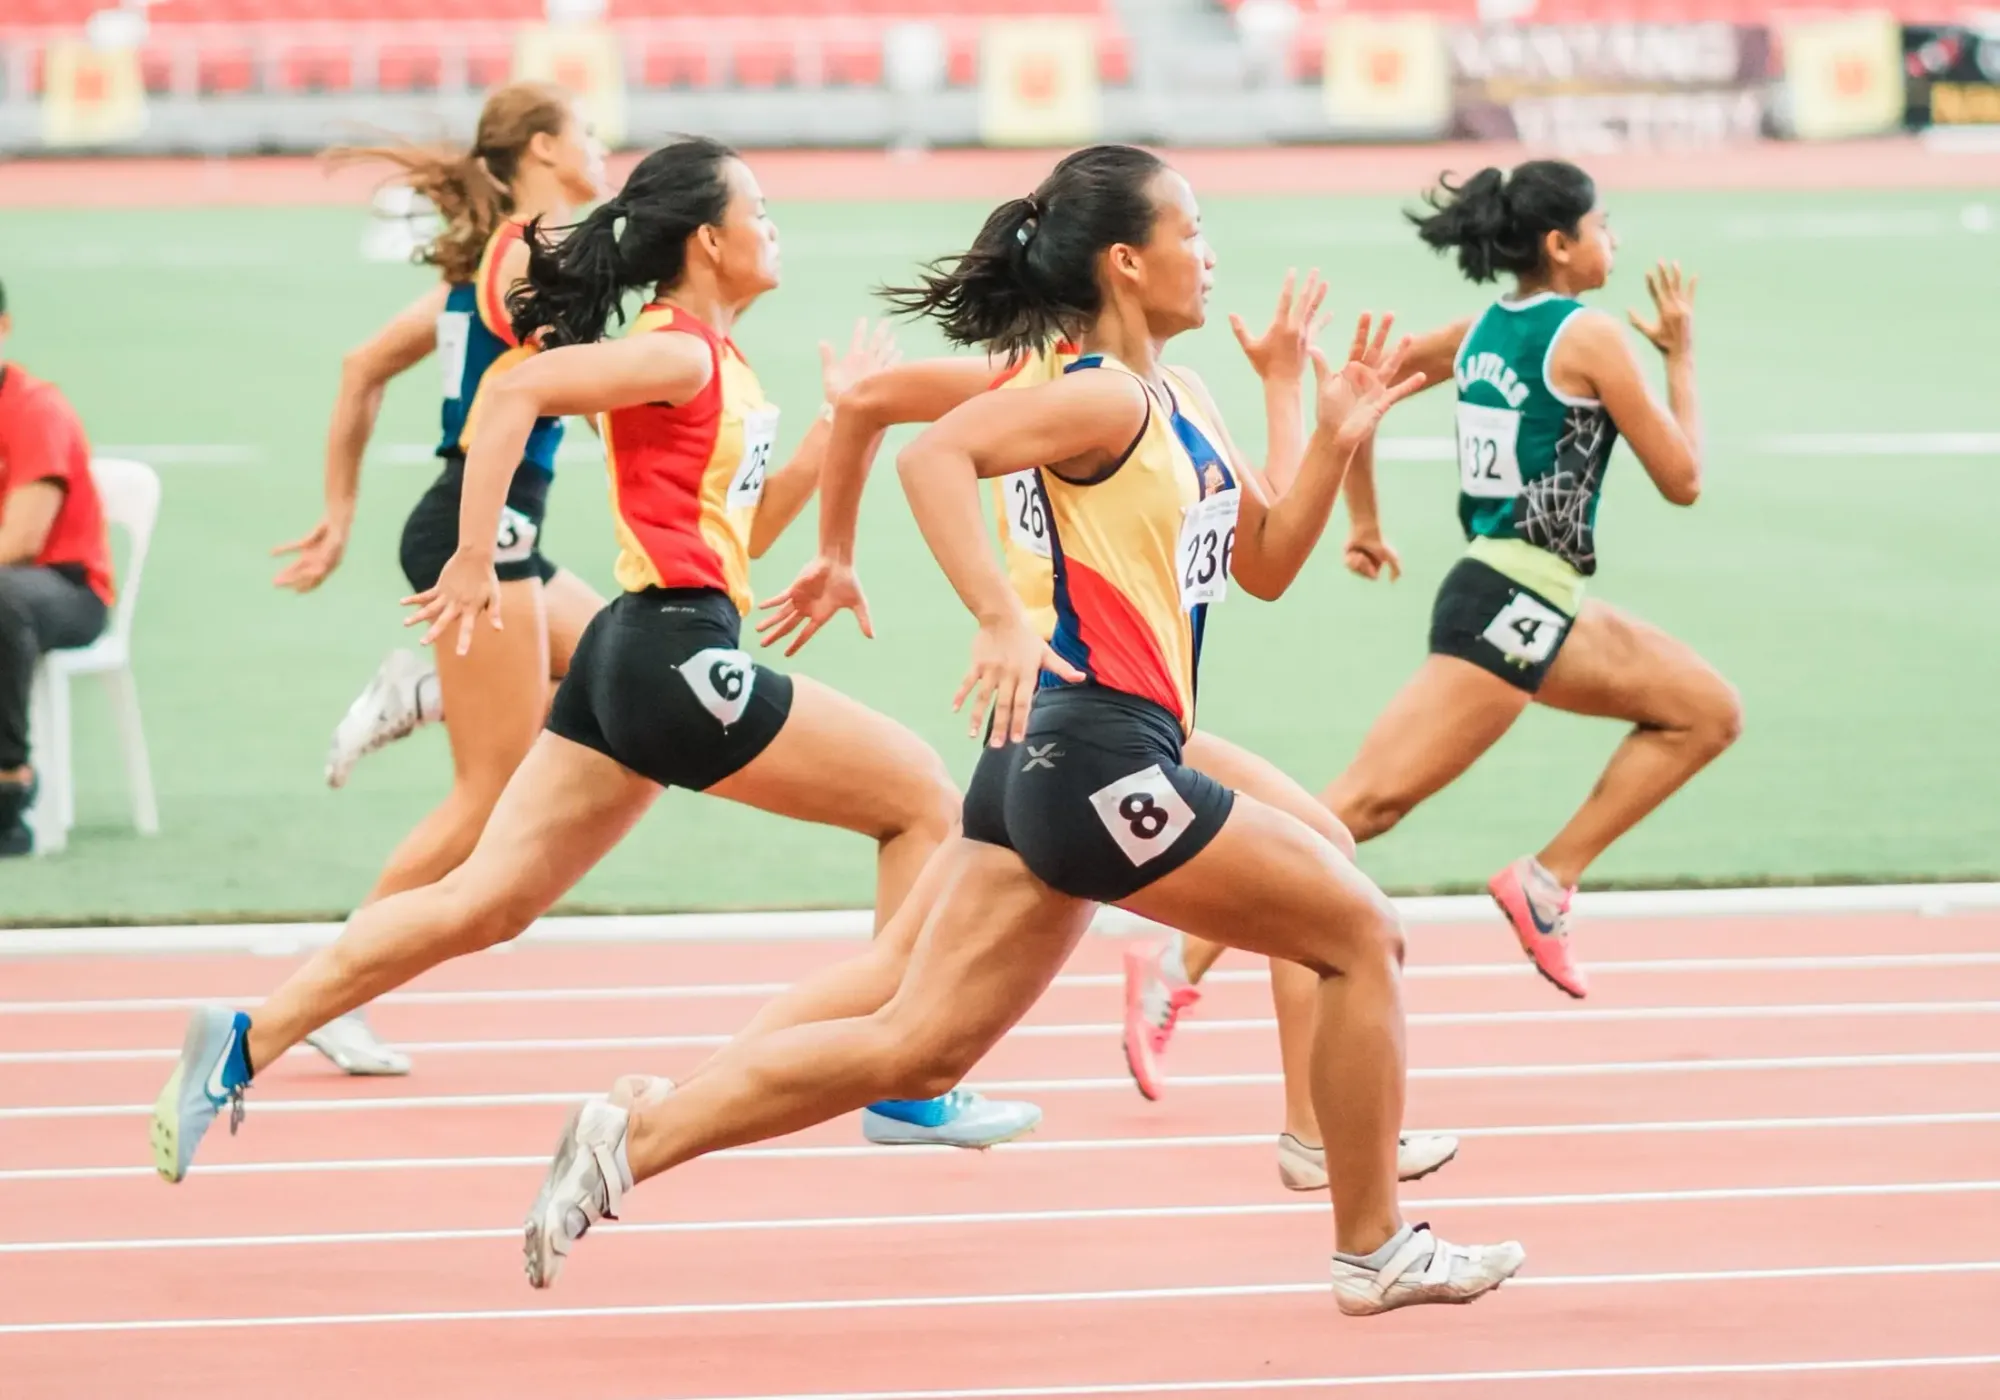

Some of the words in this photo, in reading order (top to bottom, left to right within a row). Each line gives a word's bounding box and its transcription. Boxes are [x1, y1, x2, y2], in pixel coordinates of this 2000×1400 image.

[1465, 436, 1502, 480] 32
[1510, 617, 1542, 646] 4
[709, 660, 743, 701] 6
[1119, 792, 1169, 839] 8
